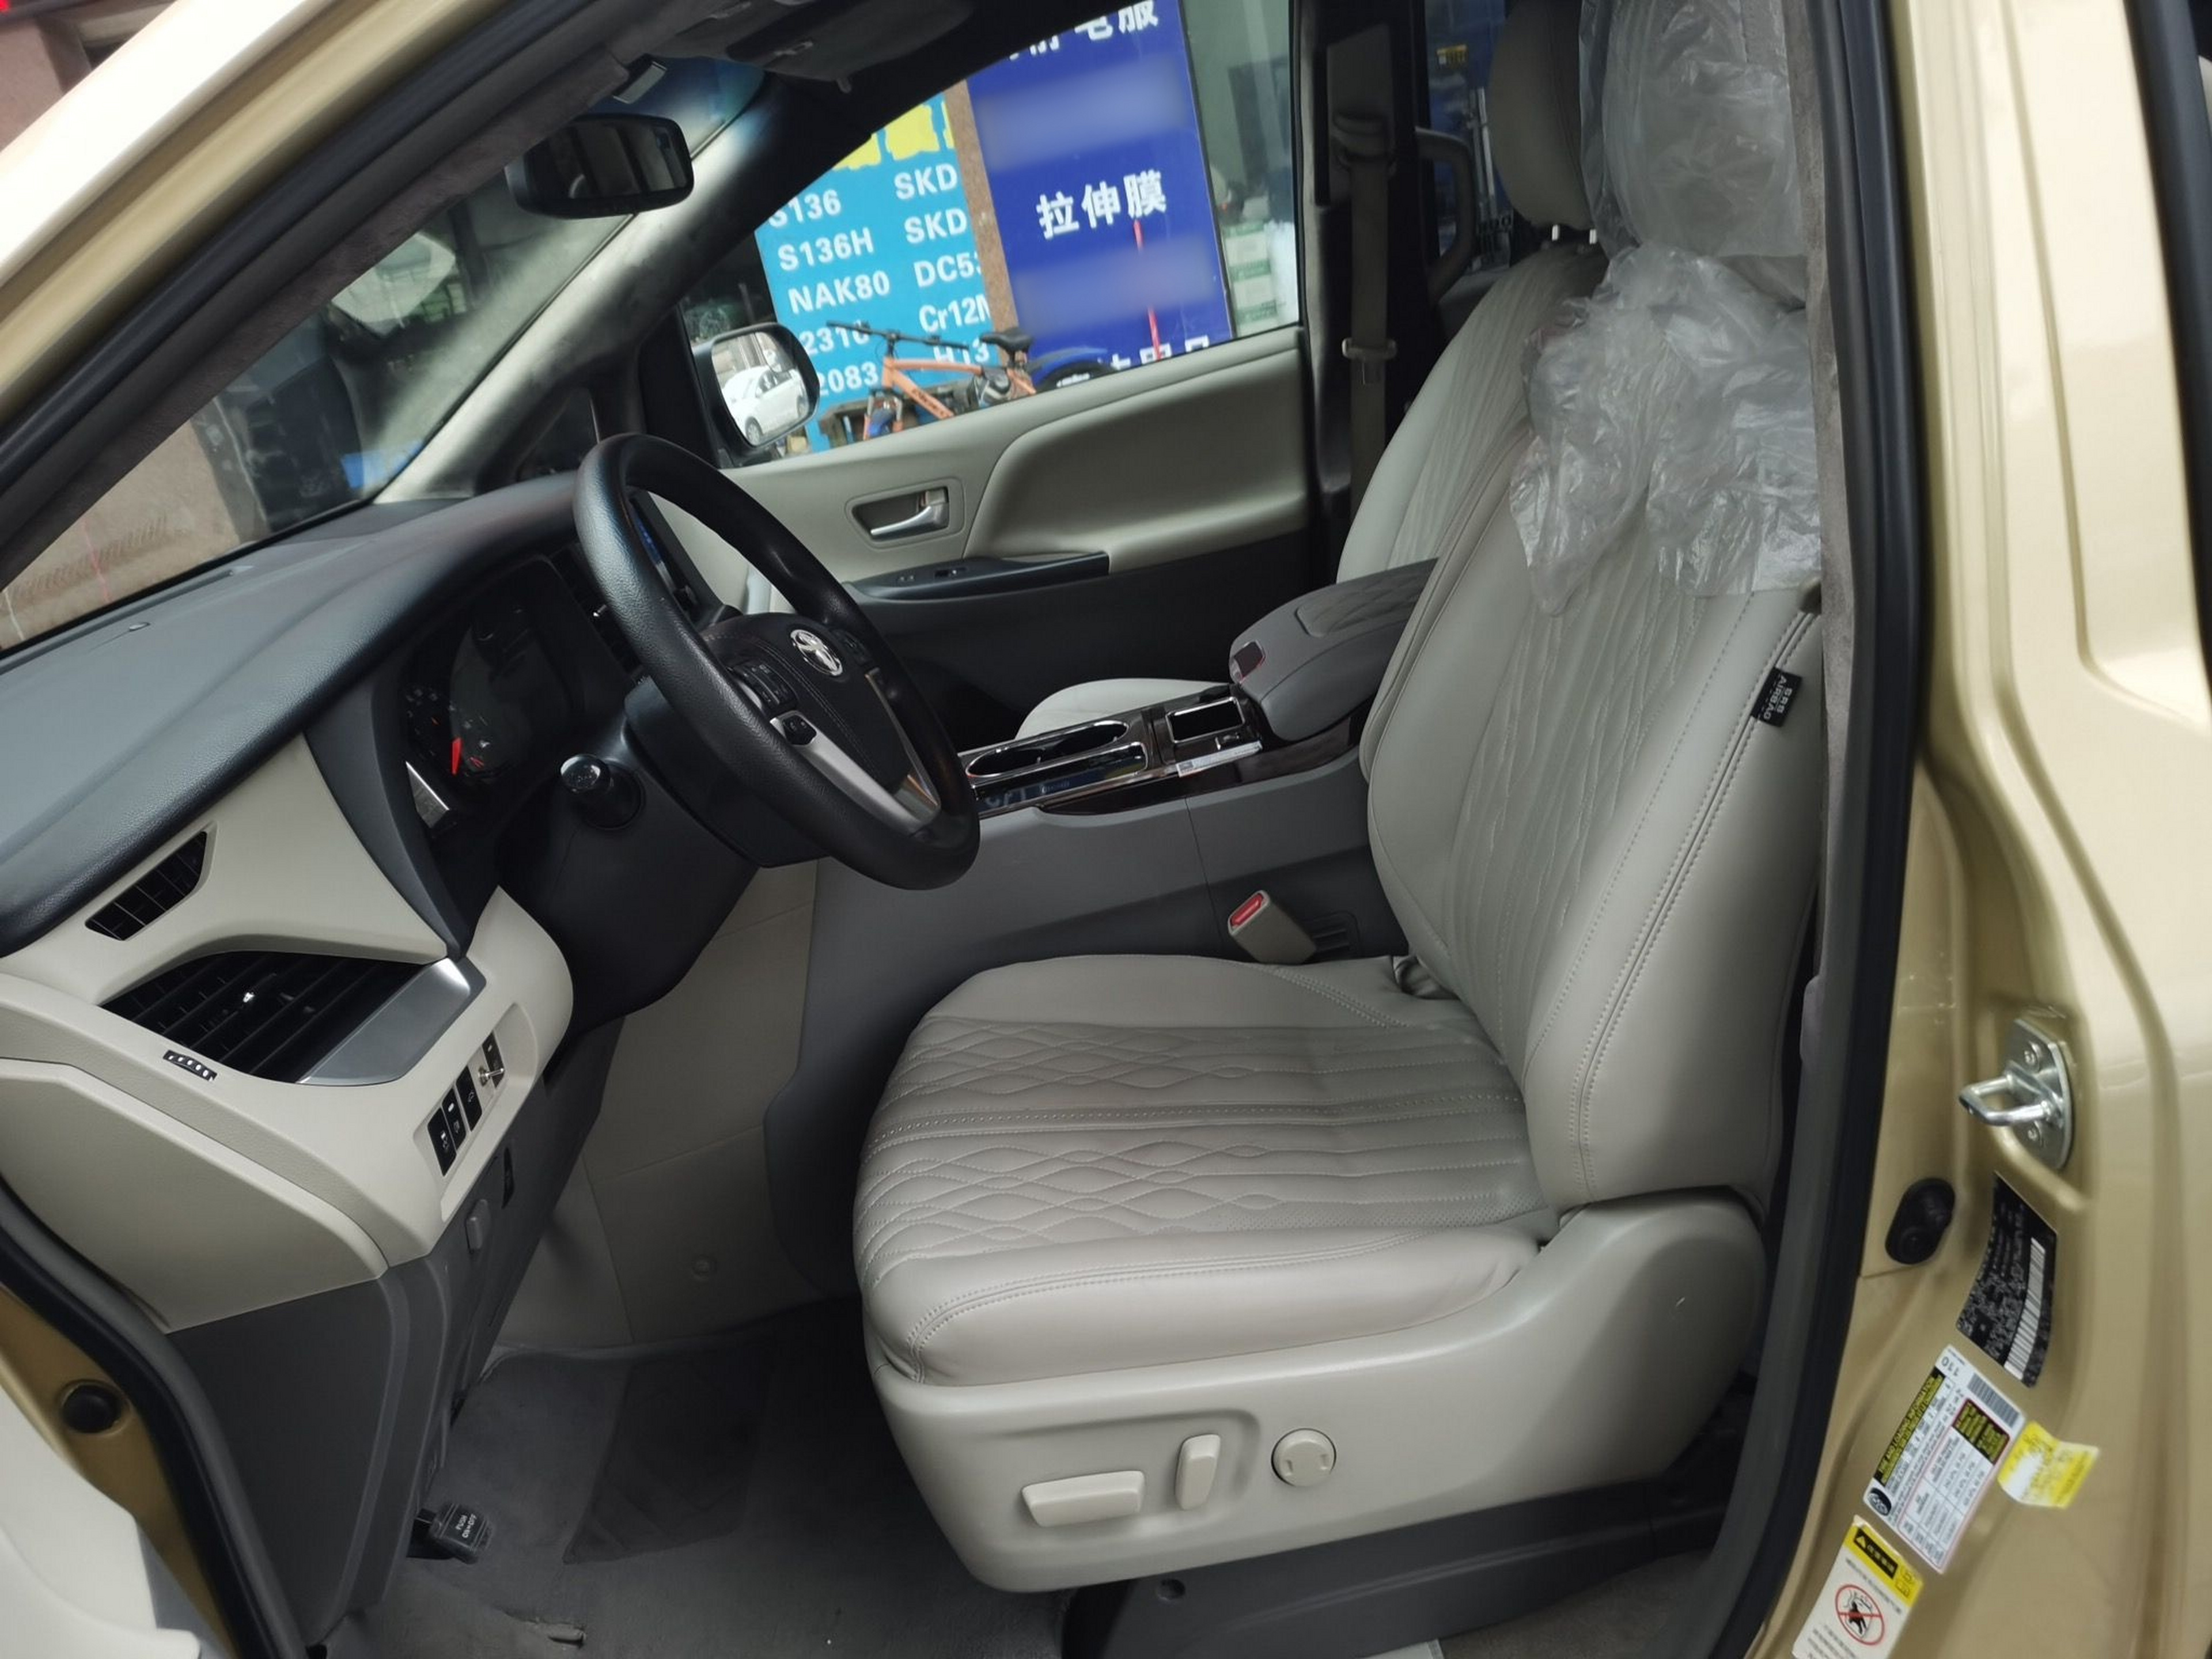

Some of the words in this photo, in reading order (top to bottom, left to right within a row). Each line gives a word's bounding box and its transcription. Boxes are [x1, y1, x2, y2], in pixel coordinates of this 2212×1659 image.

[894, 163, 957, 200] SKD
[767, 189, 842, 228] S136
[904, 208, 967, 244] SKD
[1036, 169, 1166, 240] 拉伸膜
[778, 227, 873, 271] S136H
[788, 270, 889, 315] NAK80
[1763, 675, 1787, 720] AIRBAG
